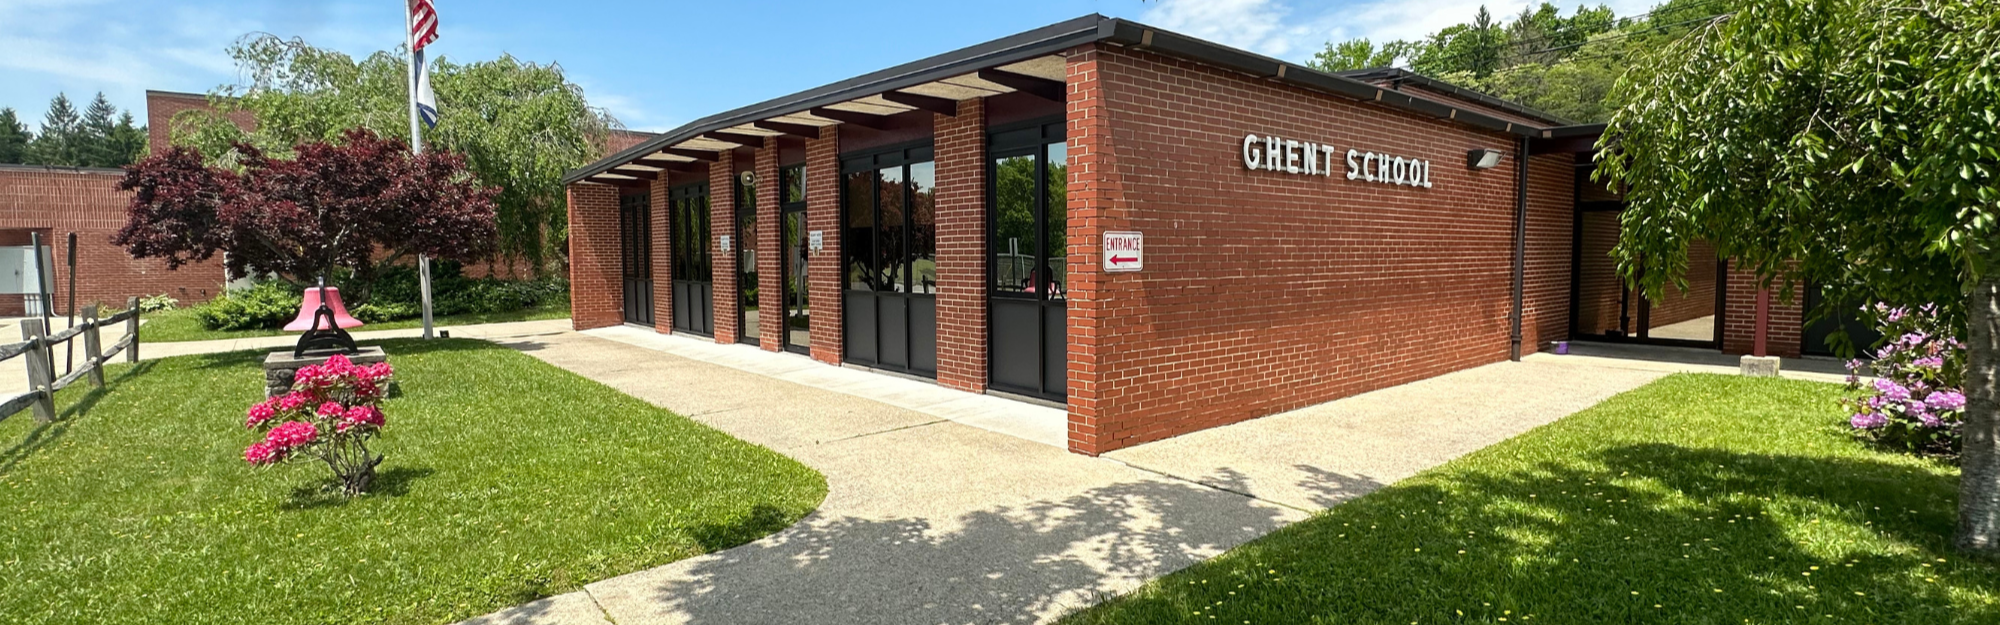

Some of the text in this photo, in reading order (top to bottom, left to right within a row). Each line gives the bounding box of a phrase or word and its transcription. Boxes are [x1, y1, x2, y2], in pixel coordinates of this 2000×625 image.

[1243, 134, 1432, 188] GHENT SCHOOL
[1106, 237, 1140, 251] ENTRANCE
